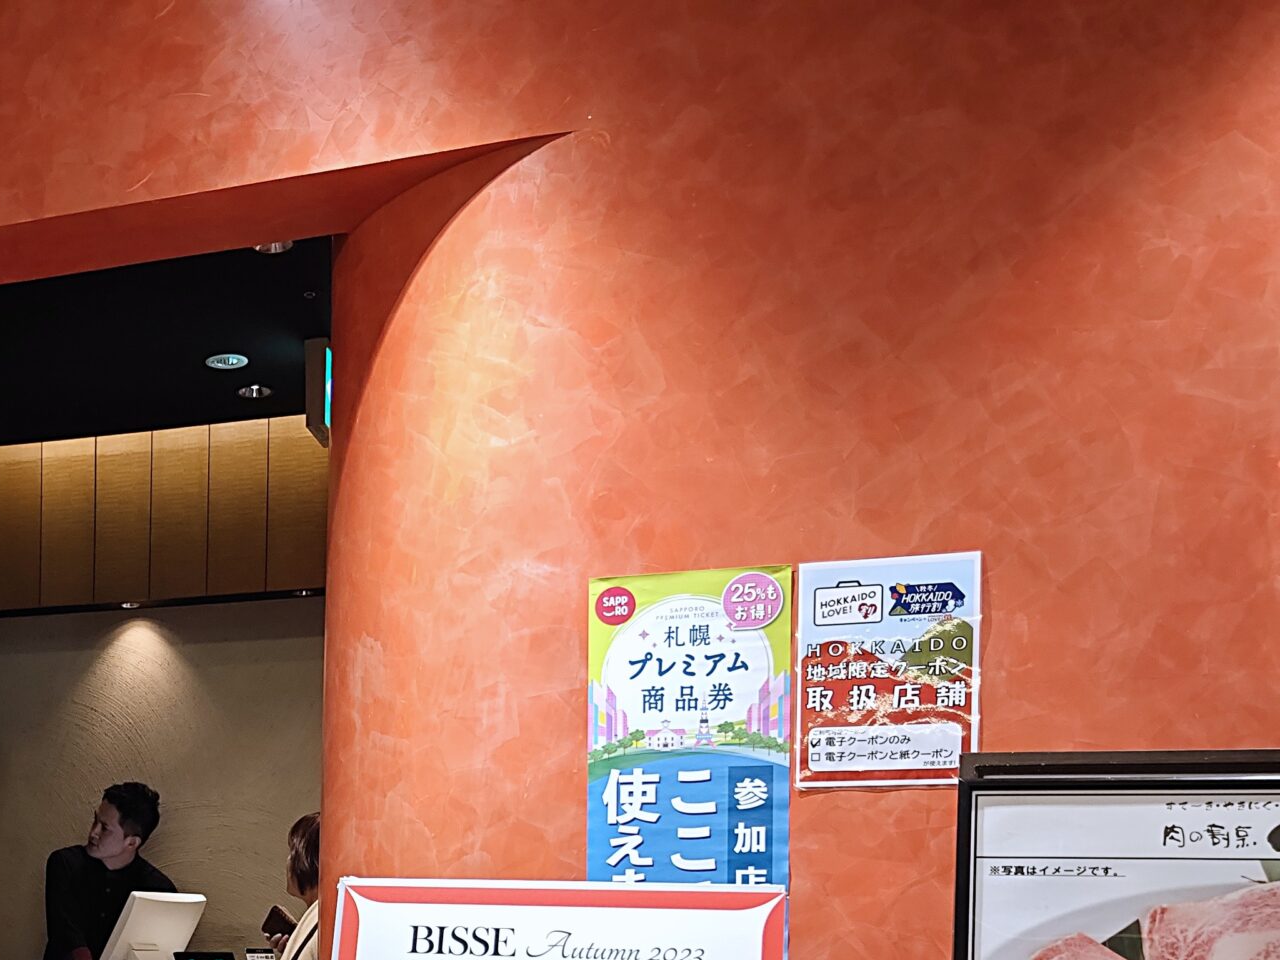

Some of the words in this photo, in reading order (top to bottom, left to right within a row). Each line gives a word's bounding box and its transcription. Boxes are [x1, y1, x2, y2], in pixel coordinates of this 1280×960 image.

[731, 582, 777, 603] 25%も
[820, 591, 877, 610] HOKKAIDO
[901, 591, 952, 604] HOKKAIDO
[670, 606, 705, 614] SAPPORO
[693, 611, 719, 619] TICKET
[822, 606, 853, 619] LOVE!
[664, 624, 711, 648] 札幌
[807, 636, 967, 658] HOKKAIDO
[628, 652, 749, 680] プレミアム
[806, 657, 967, 682] 地域限定クーポン
[641, 683, 734, 714] 商品券
[806, 681, 967, 712] 取扱店舗
[825, 734, 911, 747] 電子クーポンのみ
[825, 748, 954, 762] 電子クーポンと紙クーポン
[671, 769, 717, 884] ここ
[989, 865, 1119, 877] ※写真はイメージです。
[407, 924, 517, 957] BISSE
[526, 930, 641, 960] Autumn
